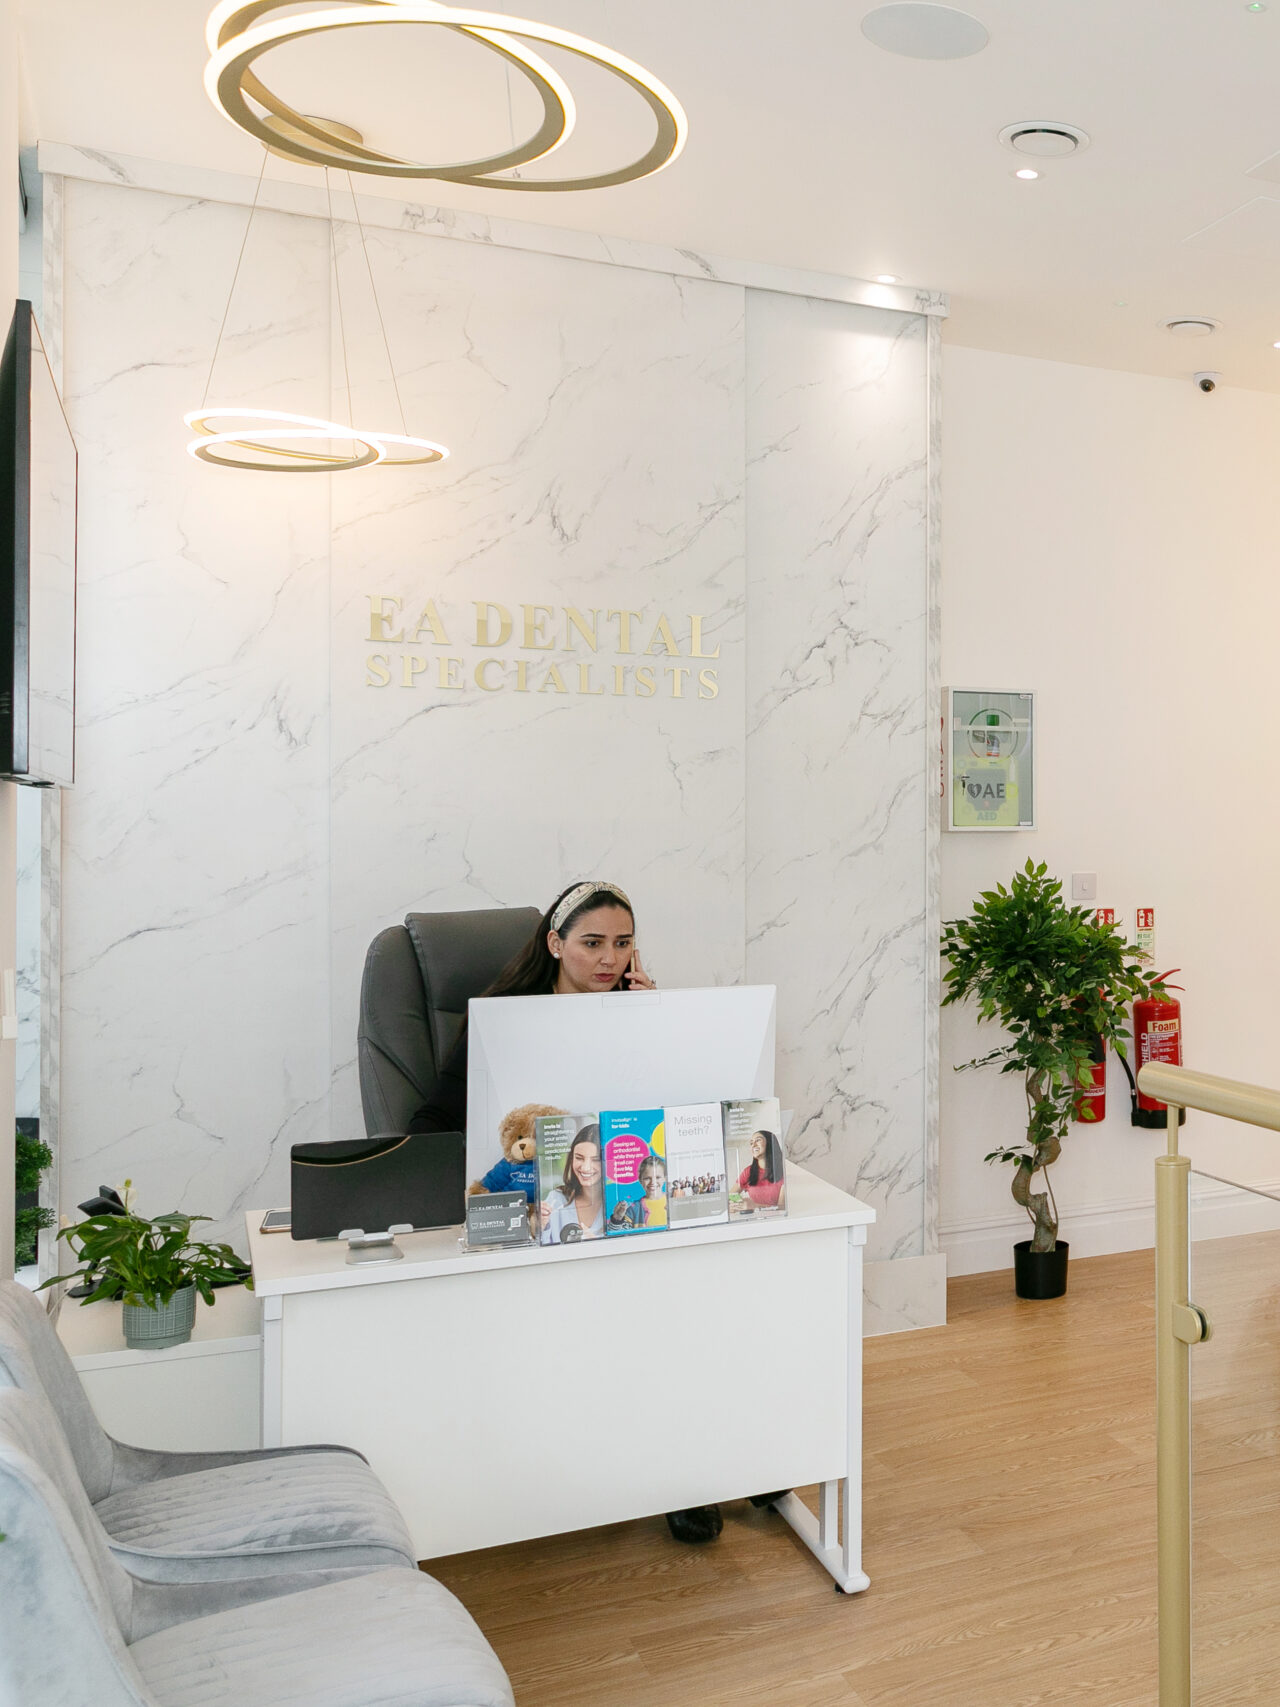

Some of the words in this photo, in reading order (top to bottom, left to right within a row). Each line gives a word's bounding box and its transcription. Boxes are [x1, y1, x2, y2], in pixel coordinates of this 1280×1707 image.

[365, 594, 452, 646] EA
[472, 601, 721, 659] DENTAL
[366, 654, 720, 700] SPECIALISTS
[1152, 1022, 1177, 1032] Foam
[674, 1116, 712, 1126] Missing
[679, 1126, 709, 1136] teeth?
